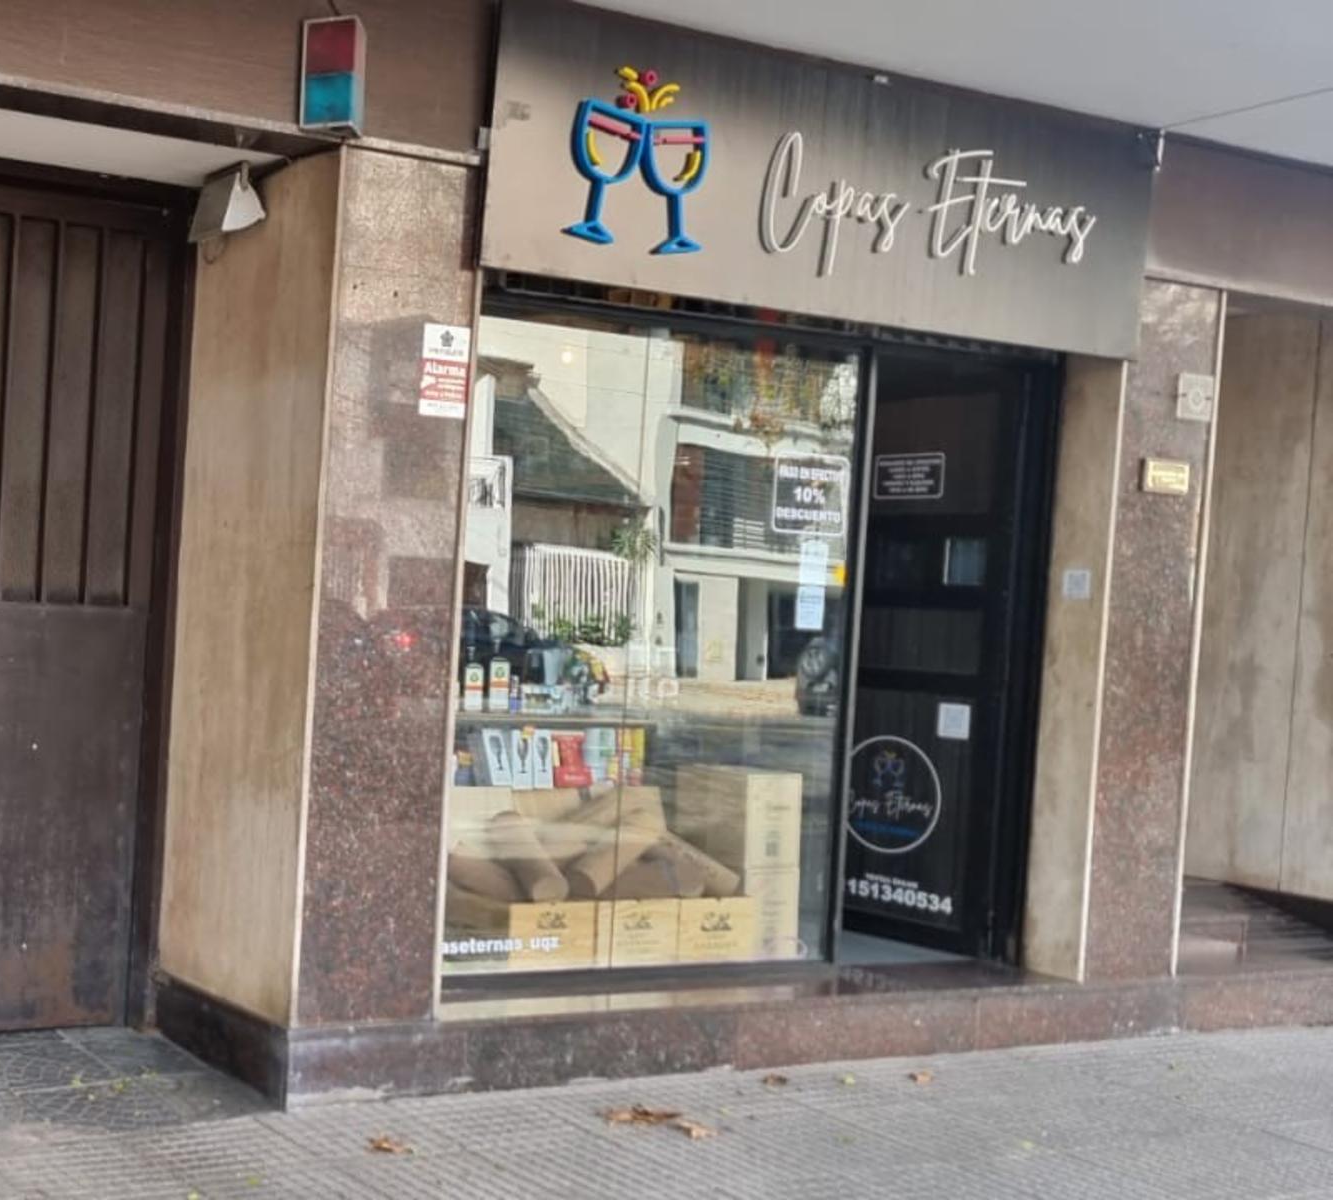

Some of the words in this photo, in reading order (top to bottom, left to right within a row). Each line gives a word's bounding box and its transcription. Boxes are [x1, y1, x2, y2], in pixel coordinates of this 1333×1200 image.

[765, 132, 911, 276] Copas
[926, 148, 1097, 276] Eternas
[424, 360, 467, 378] Alarma
[793, 486, 826, 504] 10%
[776, 506, 841, 523] DESCUENTO
[846, 878, 953, 915] 151340534
